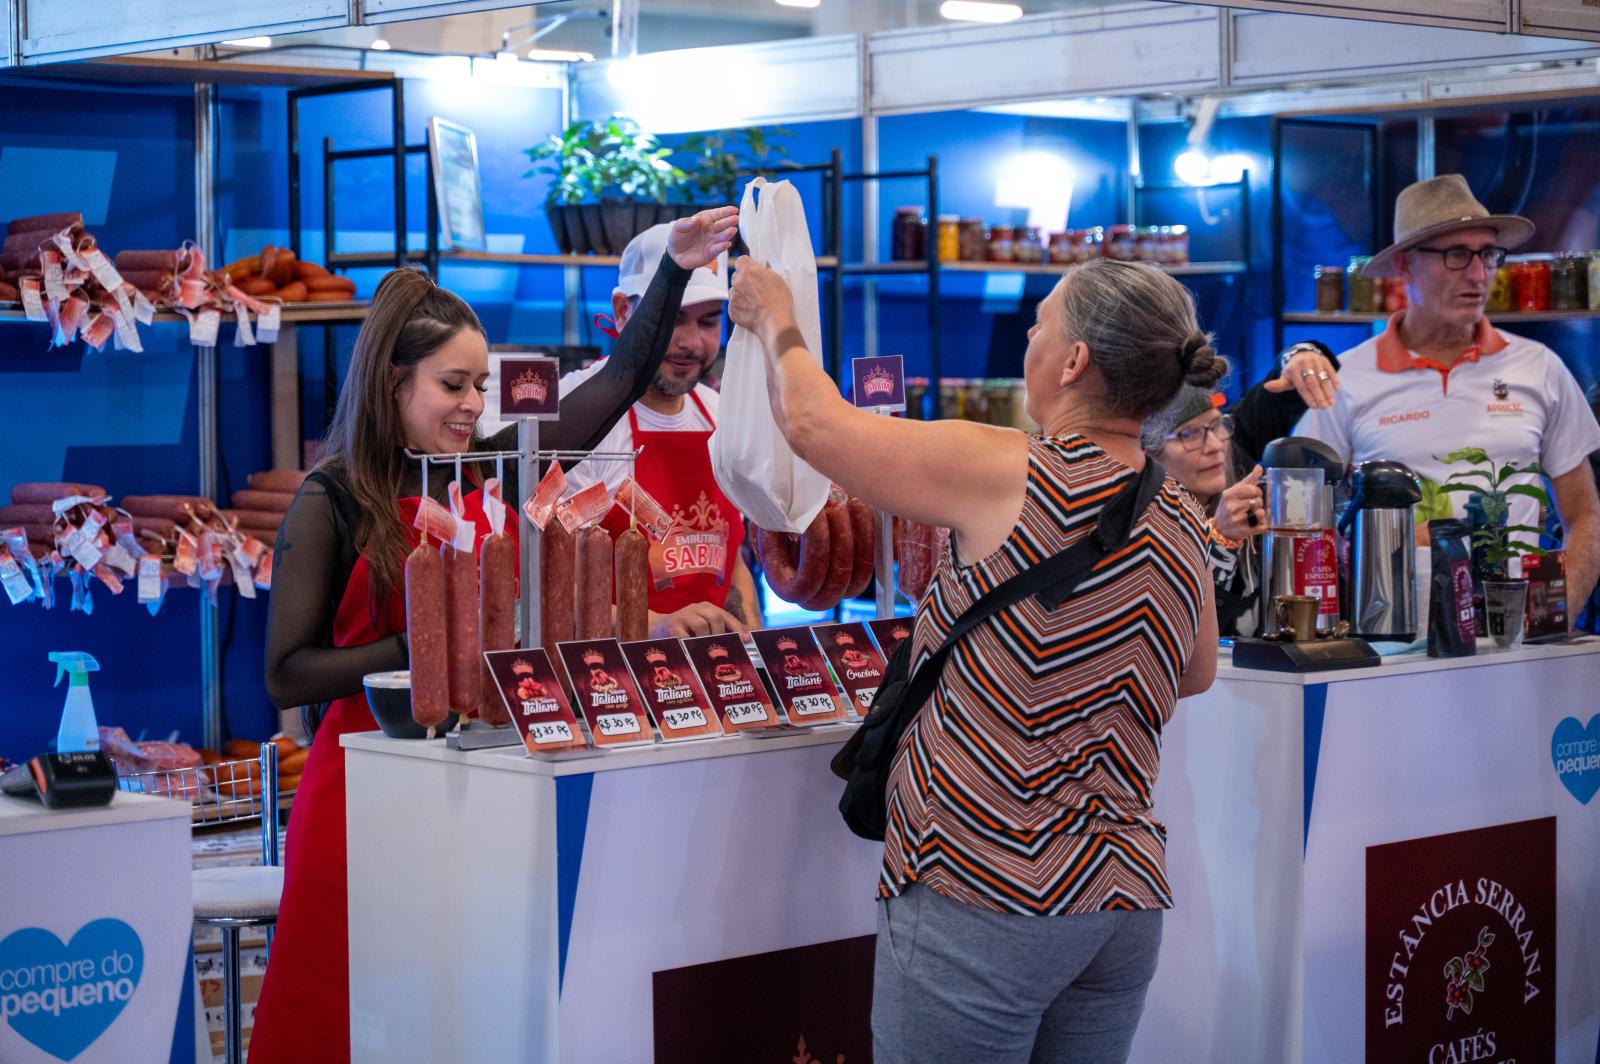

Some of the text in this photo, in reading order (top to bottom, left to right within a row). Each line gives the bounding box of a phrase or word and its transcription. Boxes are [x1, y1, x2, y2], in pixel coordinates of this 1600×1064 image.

[1379, 411, 1430, 426] RICARDO
[716, 682, 754, 698] Italiano
[784, 674, 823, 690] Italiano
[590, 690, 628, 707] Italiano
[655, 687, 693, 703] Italiano
[806, 697, 819, 706] 30
[521, 699, 560, 716] Italiano
[726, 705, 739, 719] R$
[738, 705, 751, 715] 30
[611, 717, 623, 728] 30
[676, 712, 690, 722] 30
[1556, 739, 1597, 757] compre
[1385, 876, 1542, 1030] ESTÂNCIA SERRANA
[0, 949, 134, 991] compre do
[0, 977, 134, 1020] pequeno
[1428, 1028, 1498, 1064] CAFÉS
